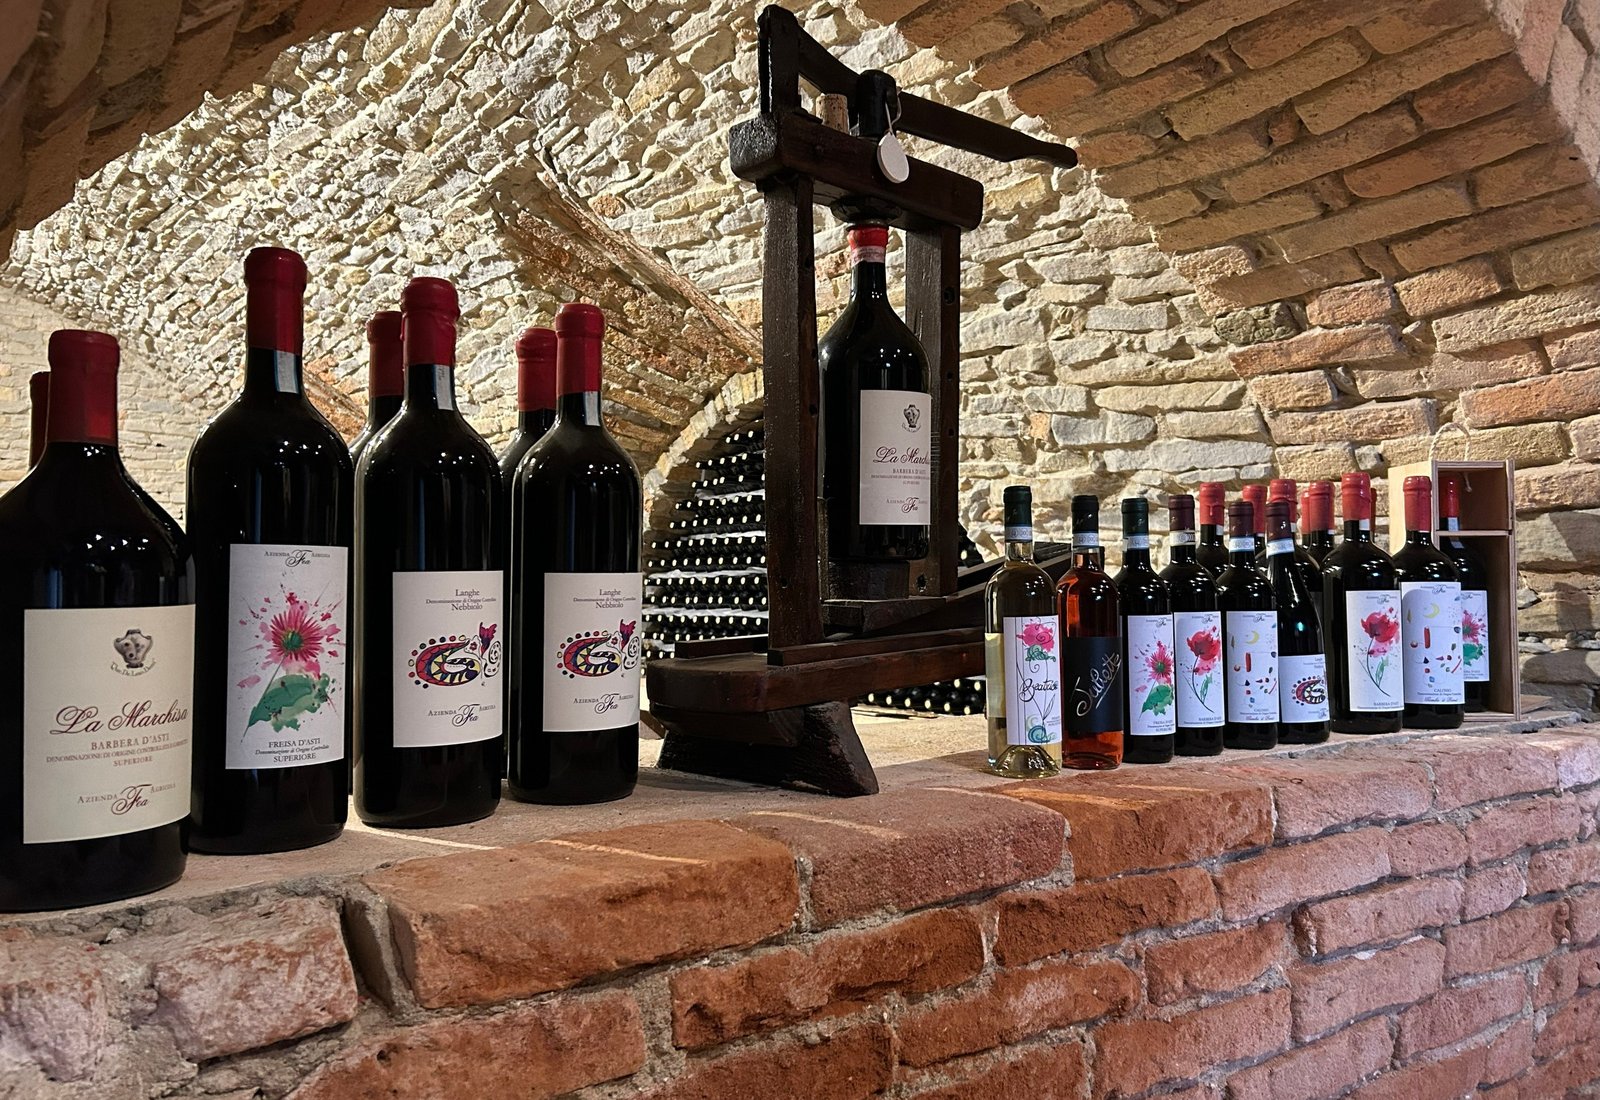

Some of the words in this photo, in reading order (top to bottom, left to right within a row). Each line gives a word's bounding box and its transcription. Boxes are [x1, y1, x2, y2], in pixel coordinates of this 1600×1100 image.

[873, 446, 900, 463] La
[285, 549, 313, 568] Fea
[455, 589, 480, 598] Langhe
[599, 588, 621, 597] Langhe
[451, 603, 483, 611] Nebbiolo
[594, 693, 620, 714] Fea
[49, 705, 104, 735] La
[107, 699, 188, 731] Marchisa
[428, 709, 457, 717] AZIENDA
[452, 703, 480, 727] Fea
[91, 738, 140, 751] BARBERA
[142, 733, 170, 745] D'ASTI
[268, 740, 296, 749] FREISA
[298, 738, 321, 746] D'ASTI
[46, 752, 101, 763] DENOMINAZIONE
[111, 749, 135, 757] ORIGINE
[113, 755, 153, 767] SUPERIORE
[273, 753, 317, 763] SUPERIORE
[78, 794, 118, 804] AZIENDA
[111, 784, 153, 816] Fea
